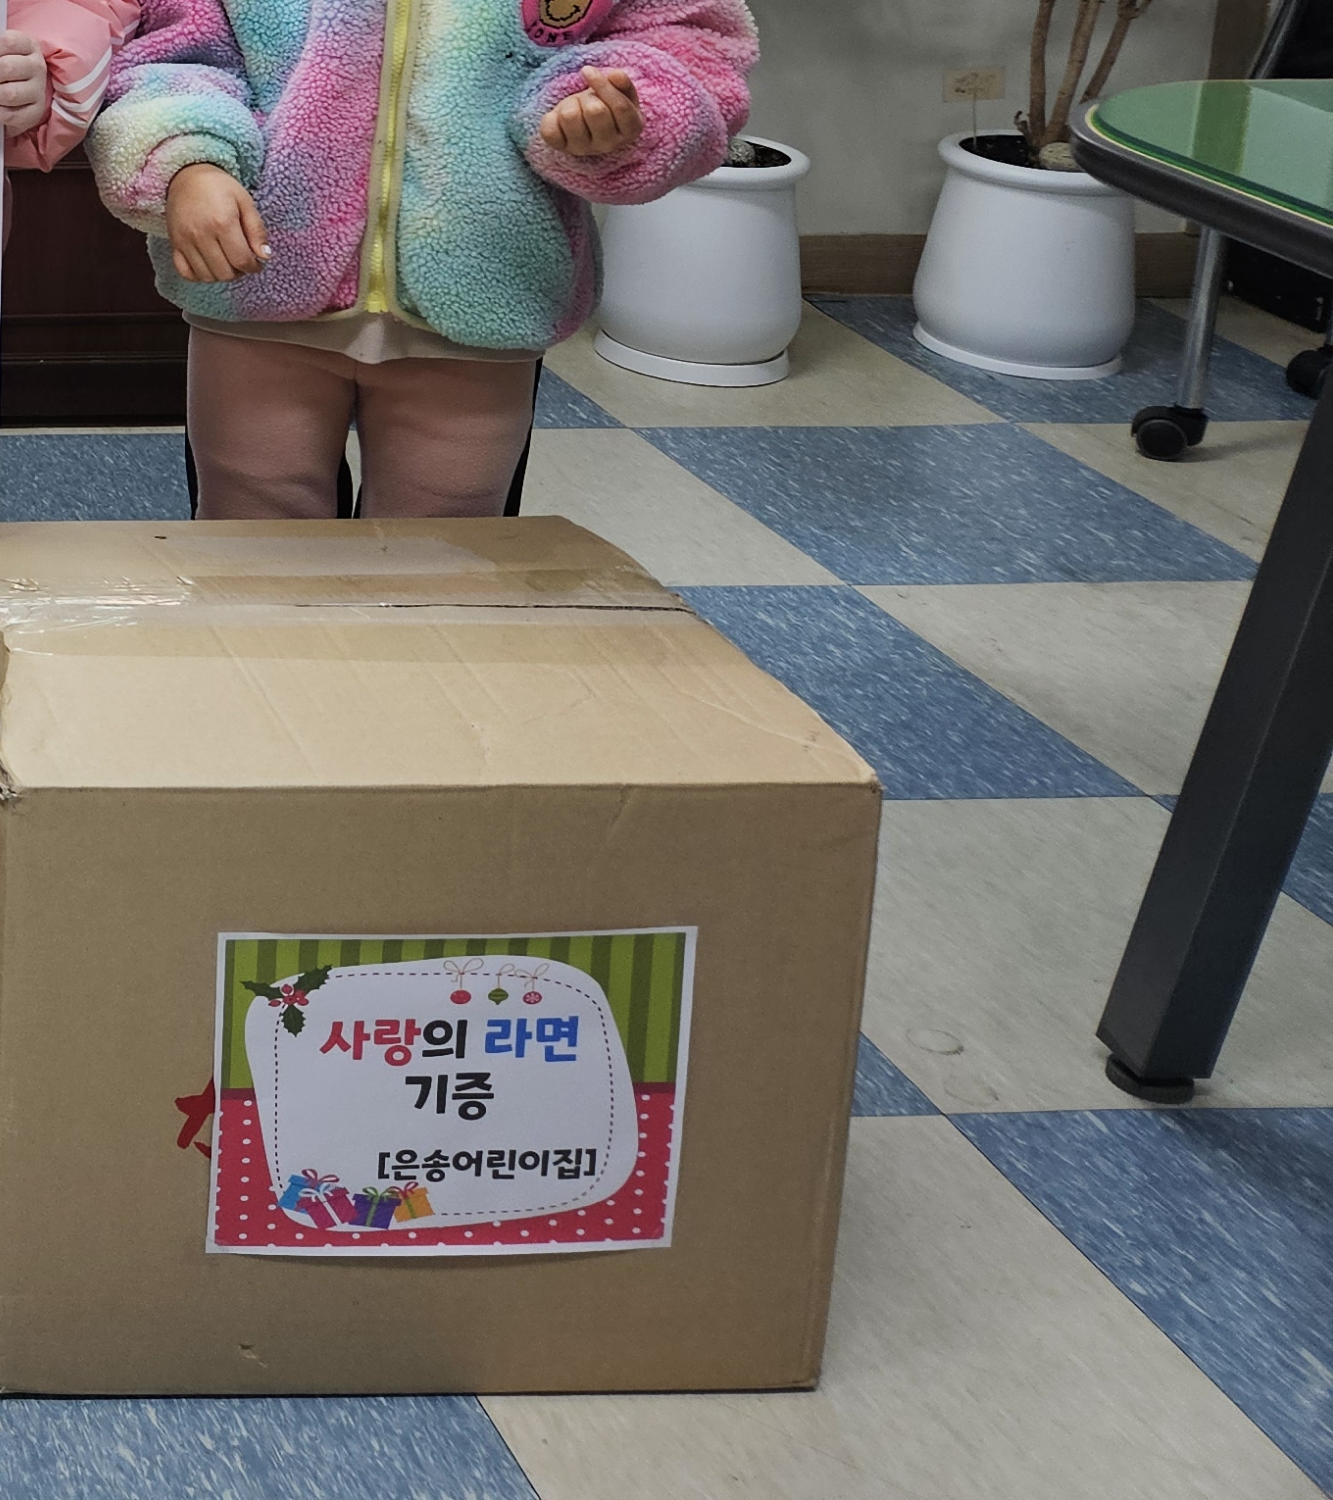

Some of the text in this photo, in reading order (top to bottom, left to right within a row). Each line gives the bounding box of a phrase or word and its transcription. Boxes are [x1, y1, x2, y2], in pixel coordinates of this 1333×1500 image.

[319, 1015, 579, 1067] 사랑의 라면
[405, 1072, 494, 1121] 기증
[378, 1148, 597, 1181] [은송어린이집]
